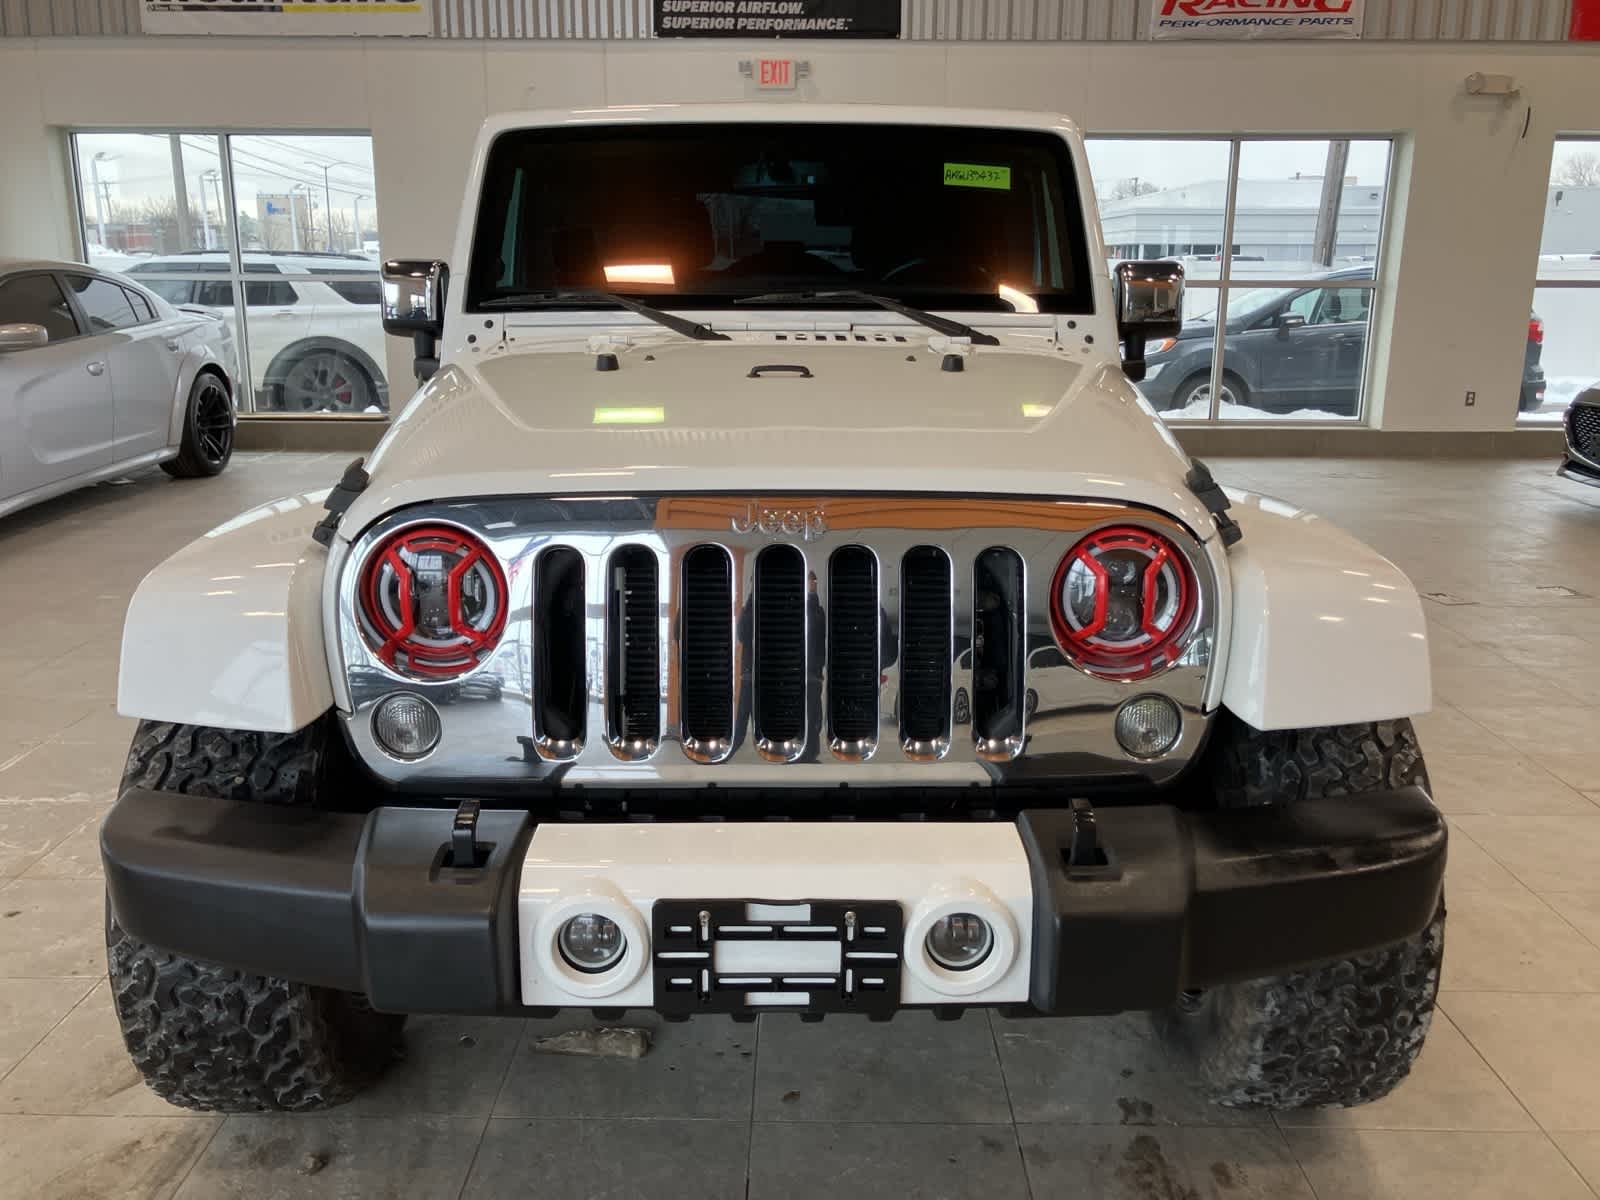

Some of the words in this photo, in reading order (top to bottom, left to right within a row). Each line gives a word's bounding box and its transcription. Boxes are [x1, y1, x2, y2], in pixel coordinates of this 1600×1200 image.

[662, 0, 733, 13] SUPERIOR
[736, 1, 805, 14] AIRFLOW.
[662, 16, 734, 29] SUPERIOR
[1159, 17, 1297, 28] PERFORMANCE
[1299, 17, 1354, 25] PARTS
[760, 60, 791, 85] EXIT
[730, 503, 827, 541] Jeep
